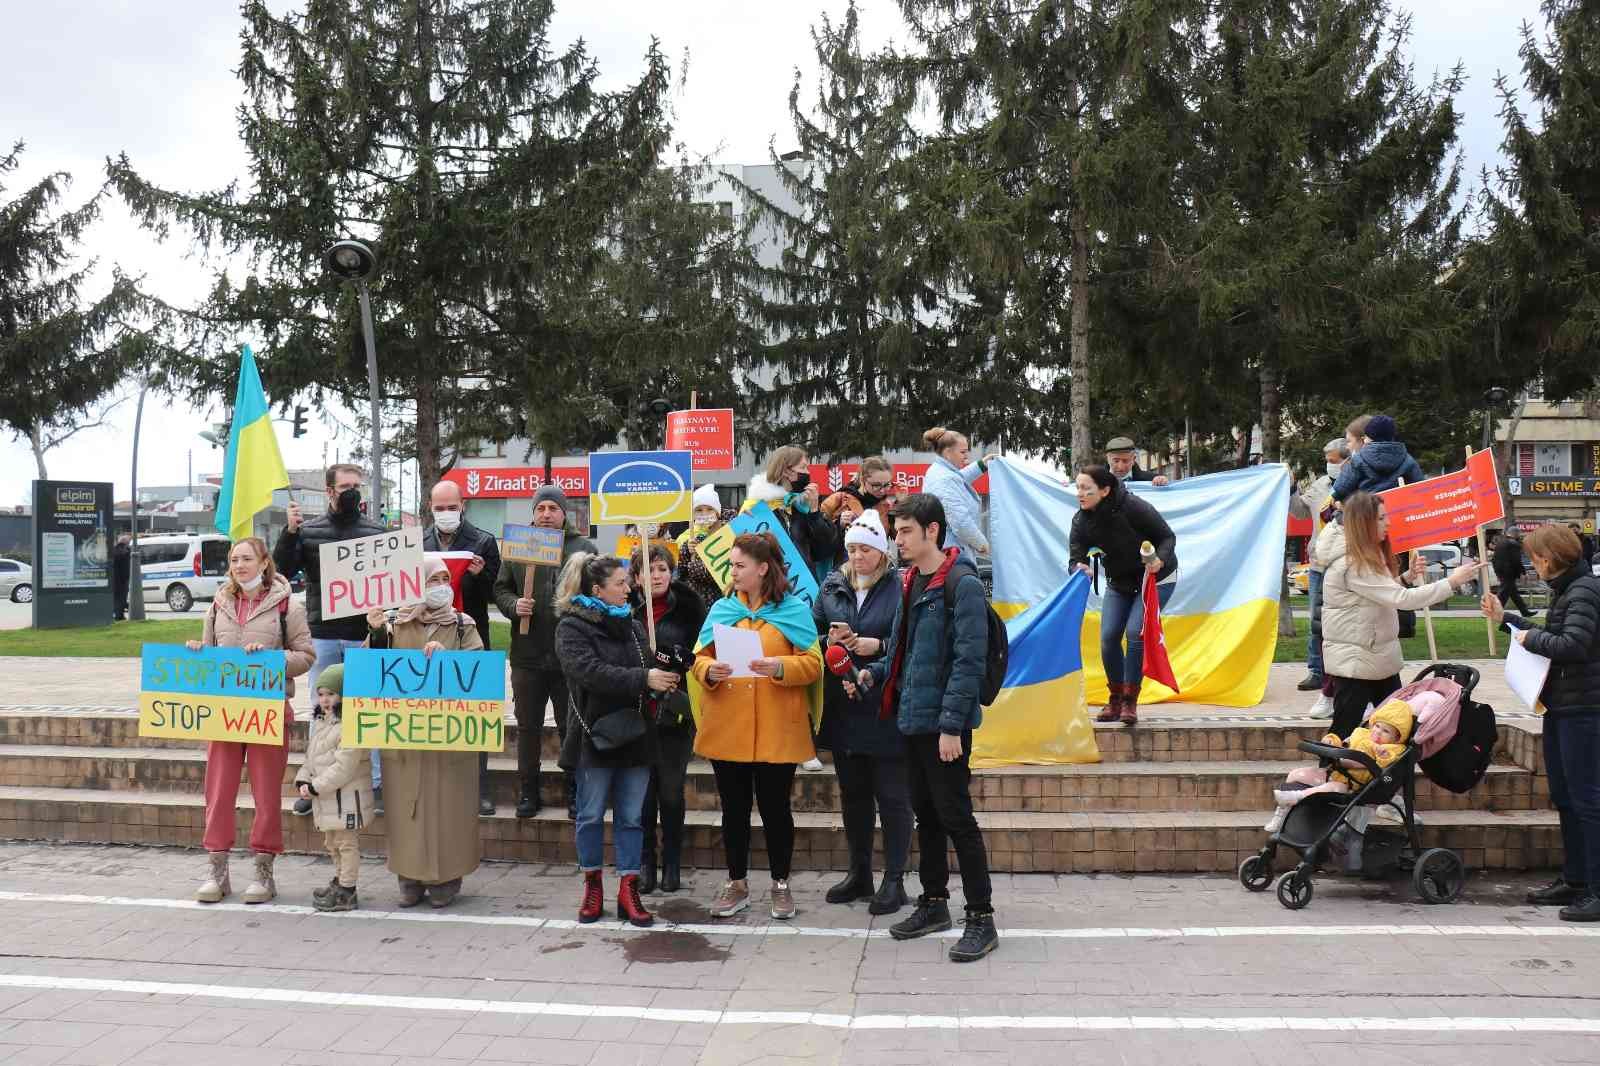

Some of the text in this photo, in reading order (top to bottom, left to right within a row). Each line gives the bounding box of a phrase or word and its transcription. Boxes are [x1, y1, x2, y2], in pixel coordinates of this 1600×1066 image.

[484, 475, 527, 491] Ziraat
[337, 535, 416, 561] DEFOL
[329, 566, 422, 613] PUTIN
[150, 657, 216, 686] STOP
[379, 656, 480, 695] KYIV
[150, 700, 278, 738] STOP WAR
[353, 698, 499, 713] IS THE CAPITAL OF
[357, 711, 502, 747] FREEDOM
